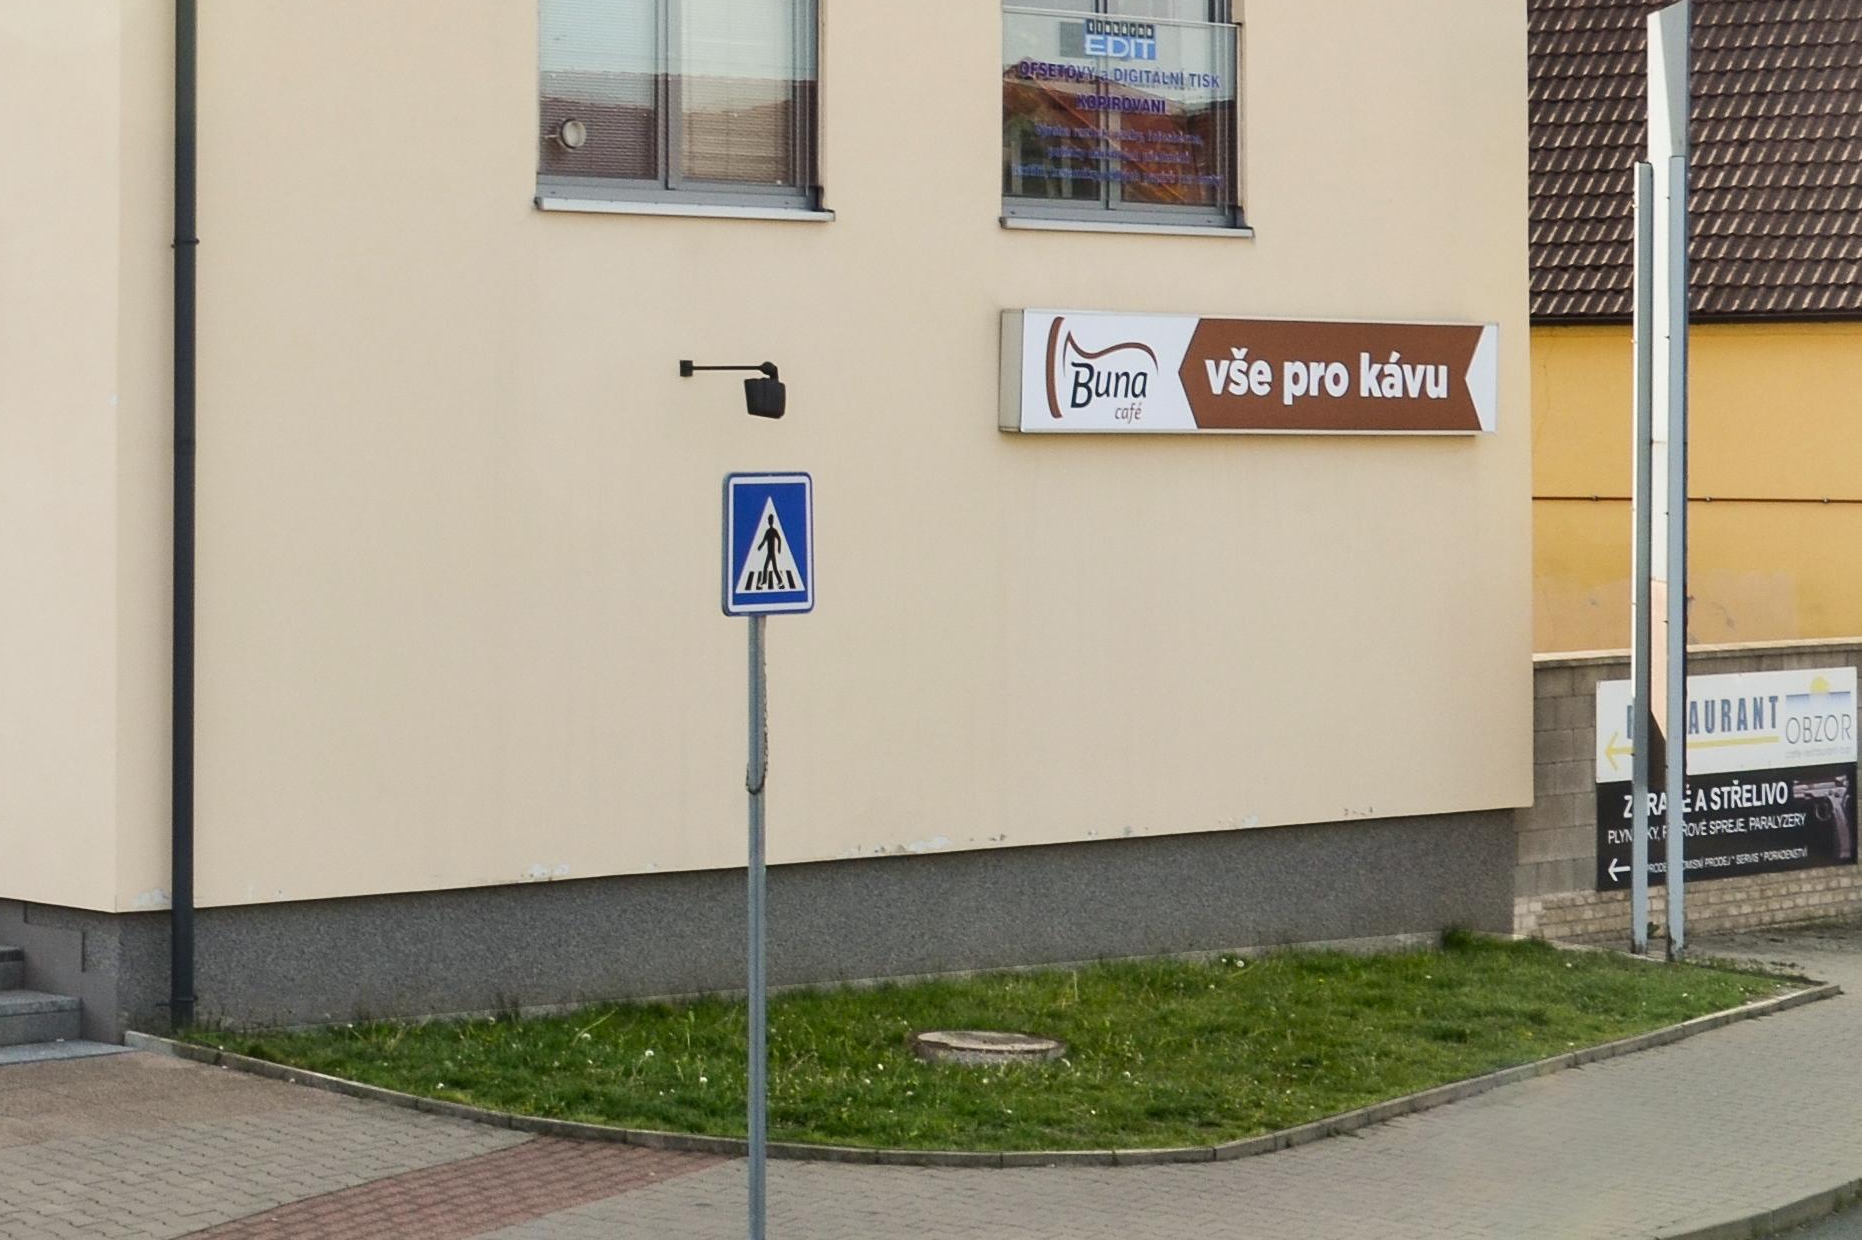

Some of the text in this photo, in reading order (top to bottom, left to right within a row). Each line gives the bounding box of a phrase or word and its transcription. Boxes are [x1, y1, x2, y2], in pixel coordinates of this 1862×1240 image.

[1084, 35, 1156, 59] EDIT
[1189, 73, 1220, 88] TISK
[1070, 347, 1448, 409] Buna vše pro kávu
[1114, 402, 1142, 424] café
[1786, 713, 1853, 744] OBZOR
[1694, 788, 1708, 812] A
[1710, 780, 1788, 811] STŘELIVO
[1749, 812, 1807, 831] PARALYZERY
